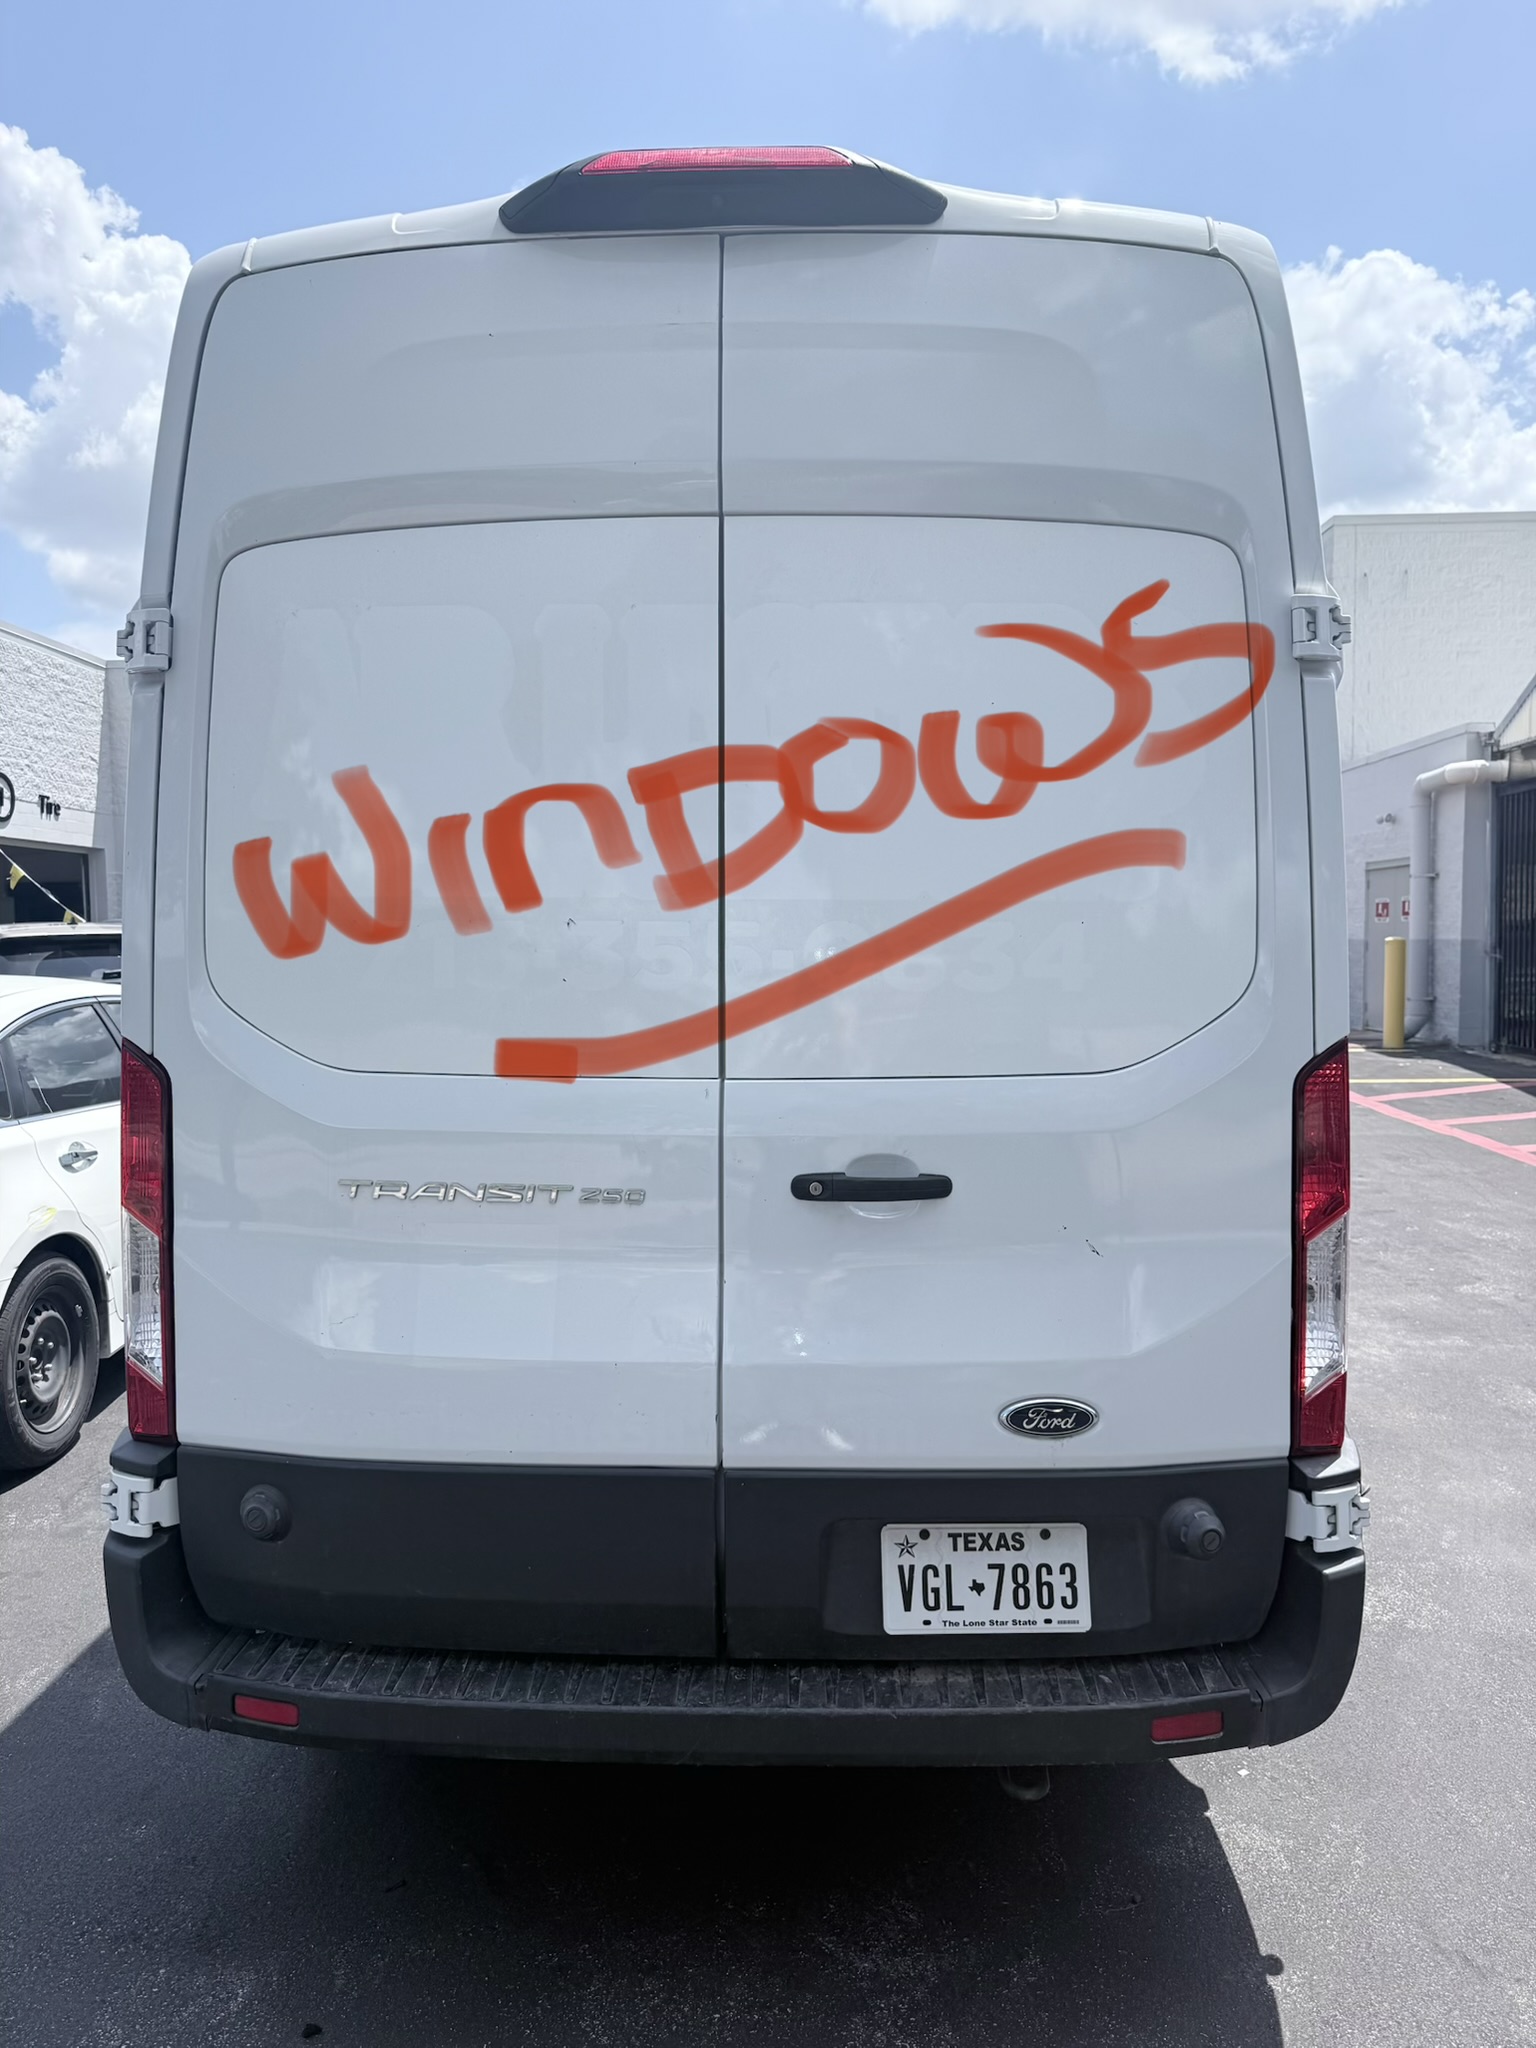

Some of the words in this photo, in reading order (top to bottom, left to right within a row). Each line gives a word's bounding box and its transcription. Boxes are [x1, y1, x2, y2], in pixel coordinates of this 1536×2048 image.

[38, 794, 61, 816] Tire
[338, 1178, 574, 1203] TRANSIT
[578, 1187, 646, 1204] 250
[1022, 1407, 1077, 1429] Ford
[947, 1532, 1025, 1552] TEXAS
[897, 1563, 965, 1613] VGL
[987, 1562, 1079, 1611] 7863
